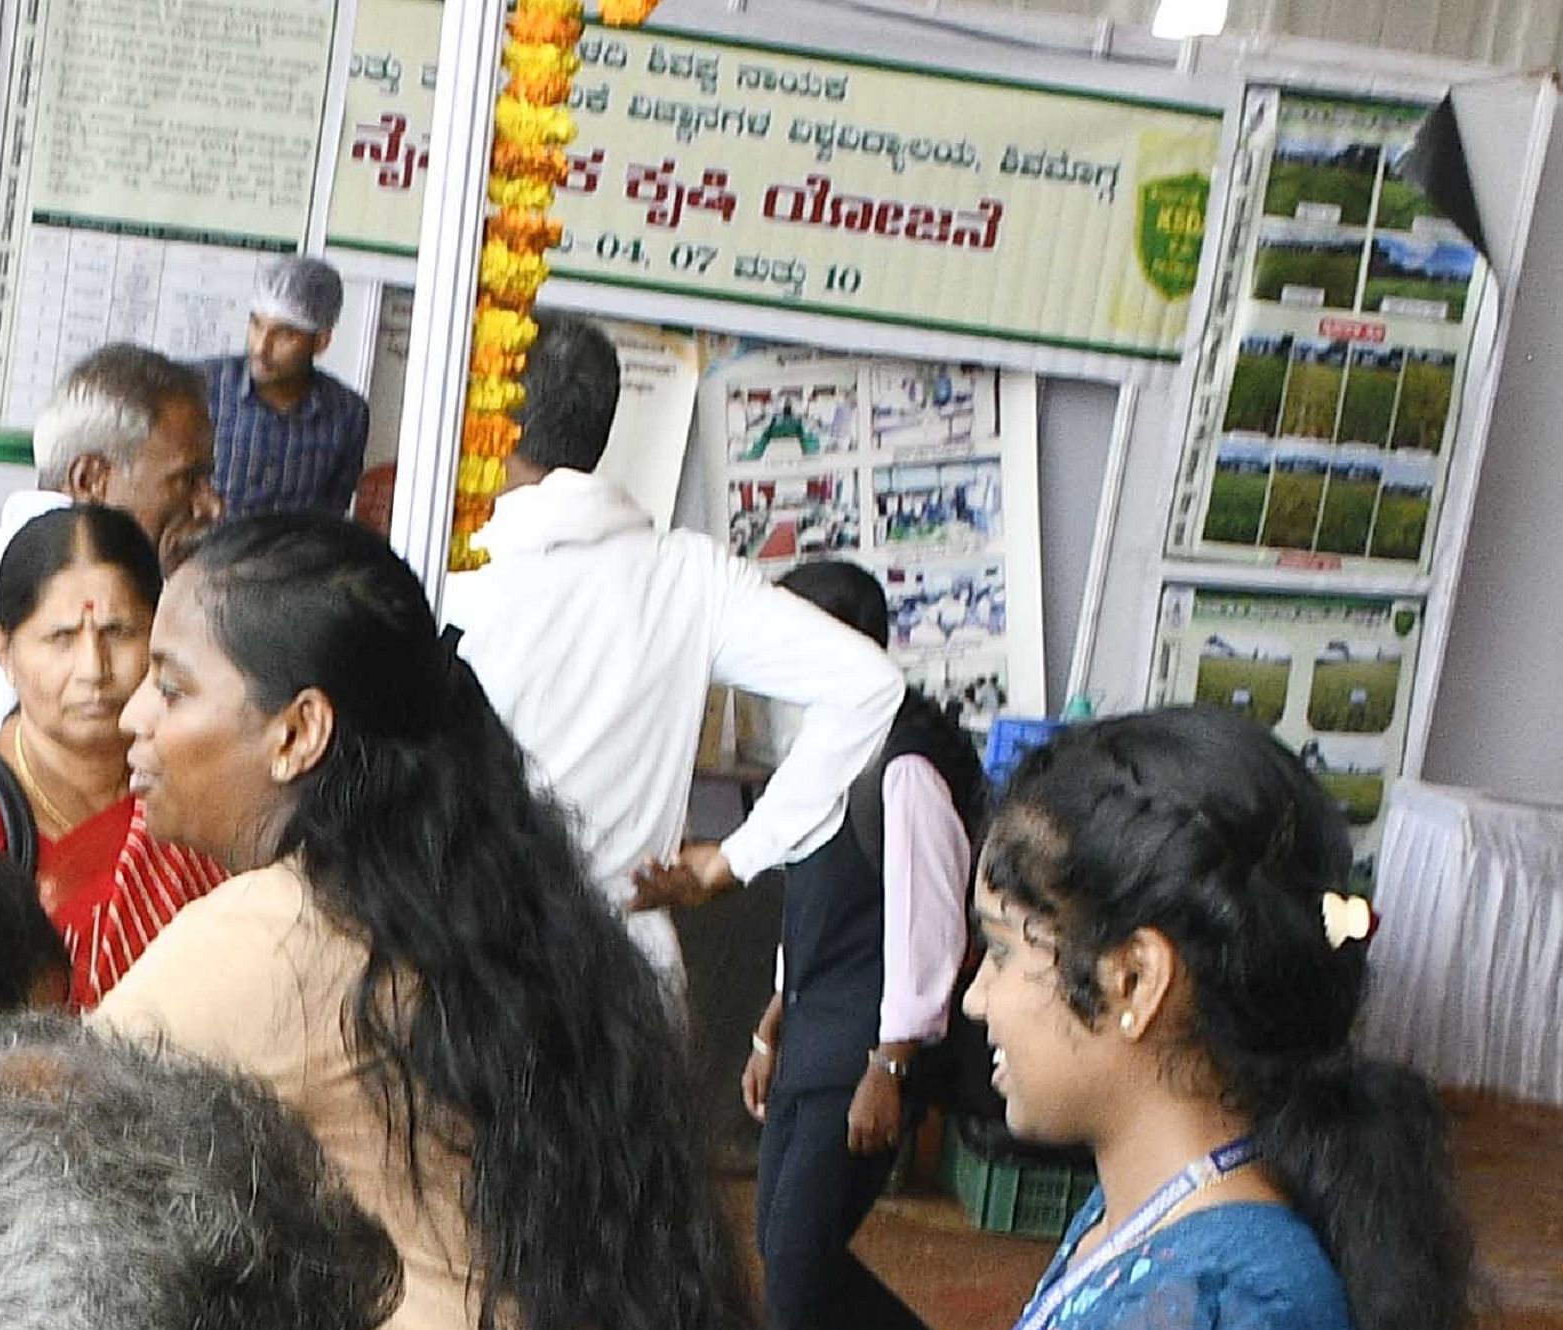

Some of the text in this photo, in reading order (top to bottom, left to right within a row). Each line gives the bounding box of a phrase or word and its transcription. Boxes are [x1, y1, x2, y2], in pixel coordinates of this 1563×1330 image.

[737, 64, 849, 102] ನಾಯಕ
[626, 157, 738, 229] ಕೃಷಿ
[762, 172, 1006, 251] ಯೋಜನೆ
[669, 243, 719, 273] 07
[733, 253, 807, 297] ಮತ್ತು
[825, 263, 862, 294] 10
